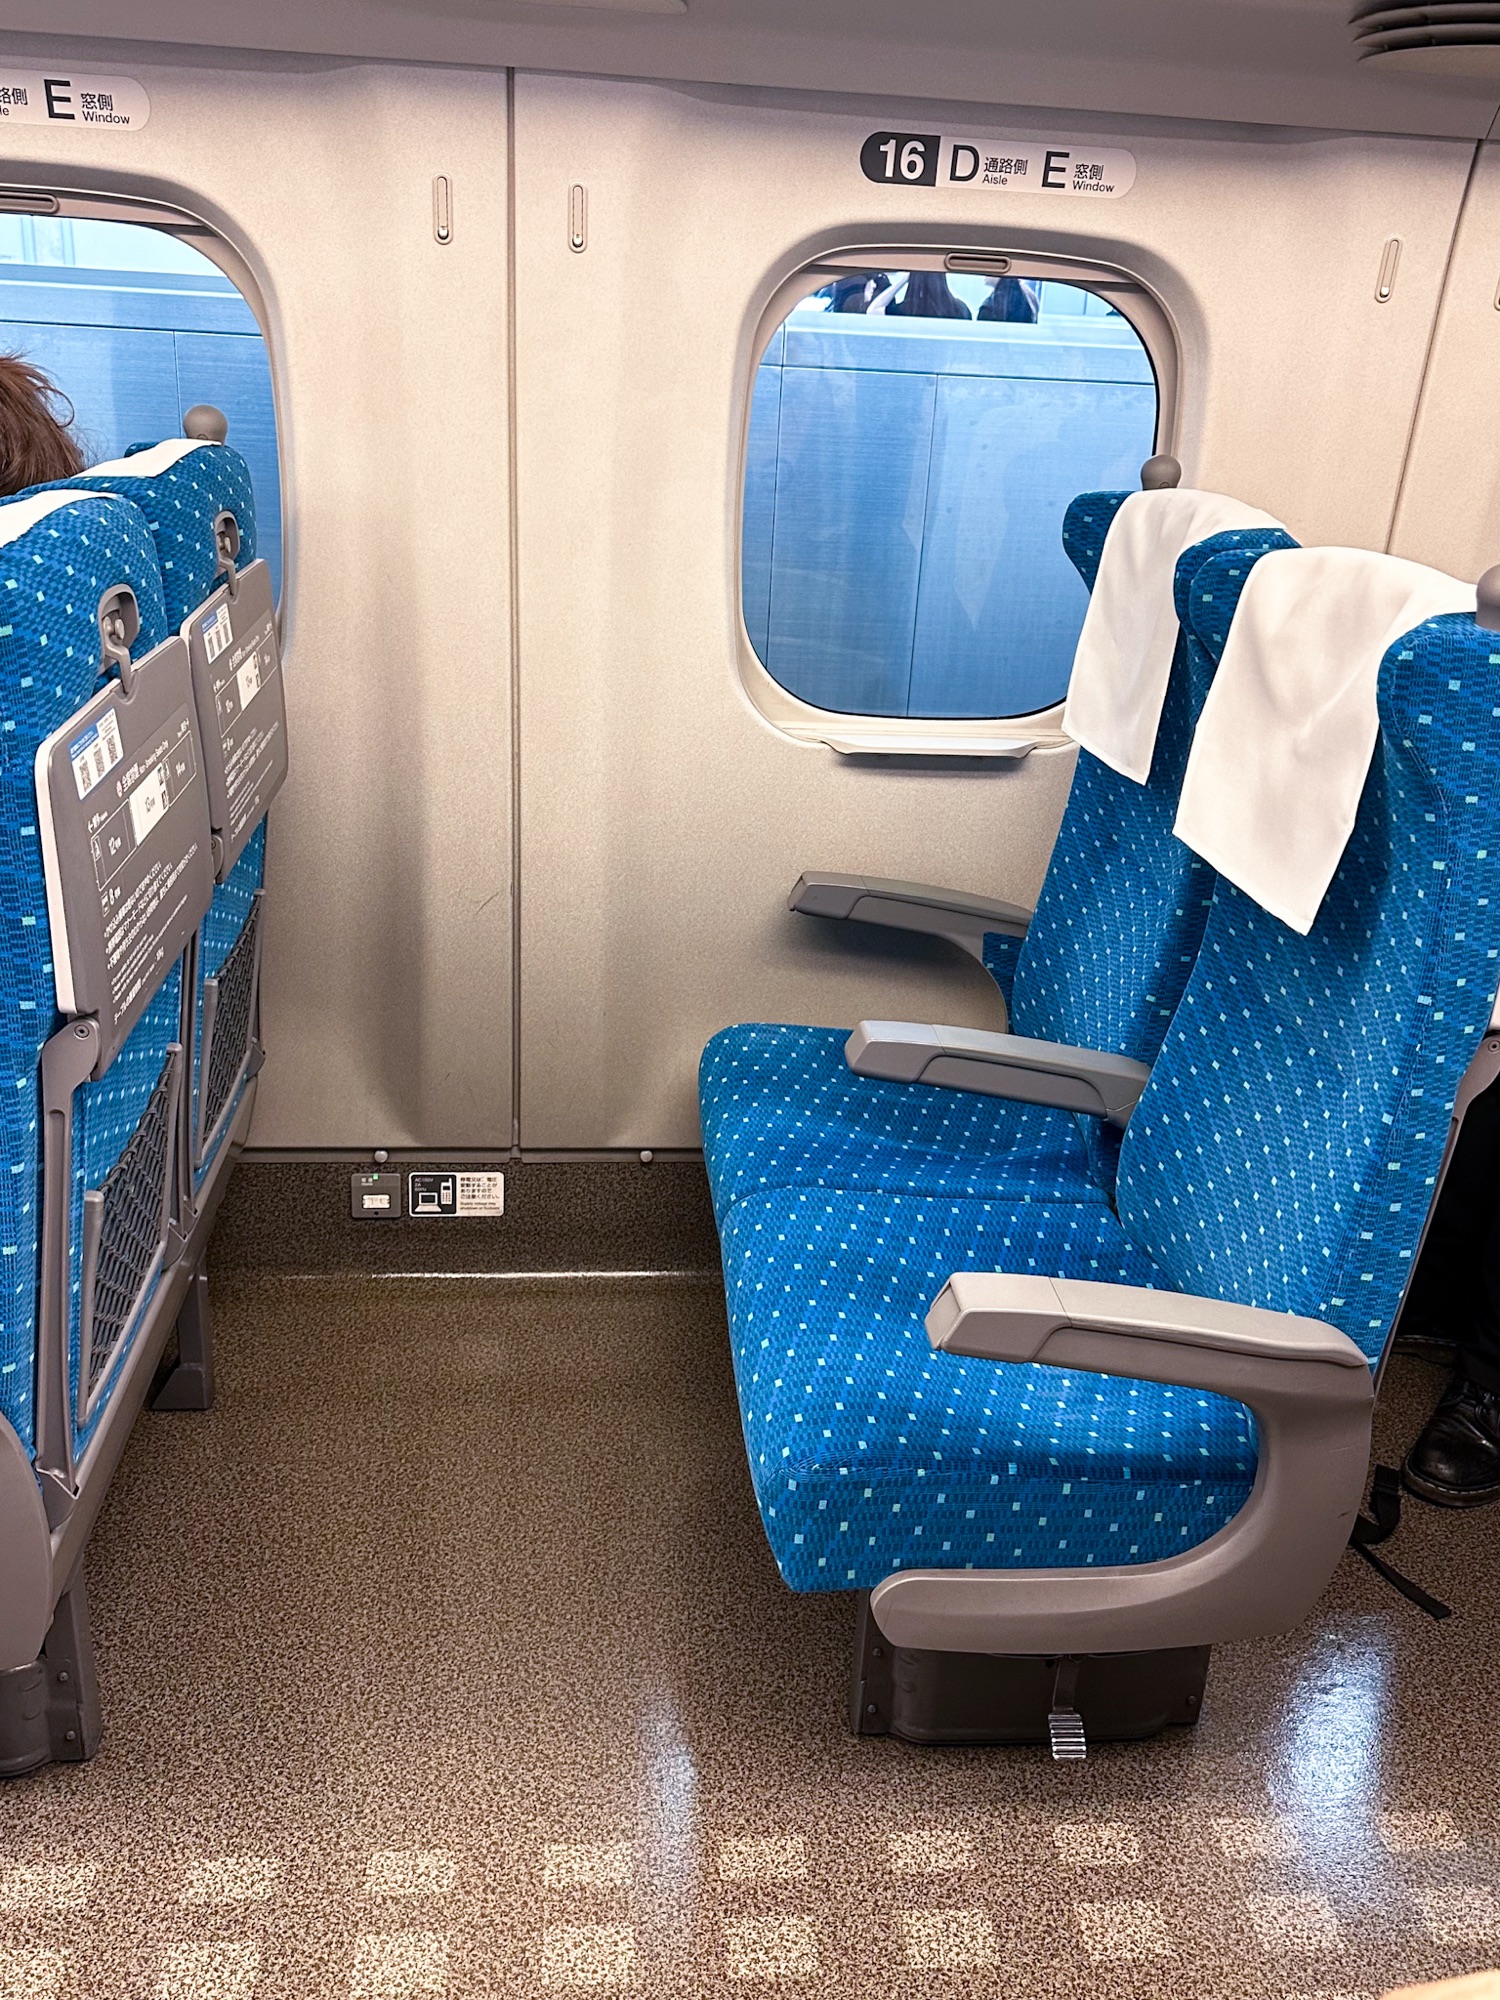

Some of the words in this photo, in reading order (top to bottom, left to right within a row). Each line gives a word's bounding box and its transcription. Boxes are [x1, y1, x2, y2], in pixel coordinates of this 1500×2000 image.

[44, 79, 75, 120] E
[81, 93, 114, 111] 窓側
[82, 111, 130, 124] Window
[879, 139, 926, 181] 16
[949, 144, 980, 182] D
[983, 157, 1028, 176] 通路側
[1041, 150, 1070, 189] E
[1073, 163, 1104, 181] 窓側
[982, 174, 1008, 186] Aisle
[1072, 180, 1115, 193] Window
